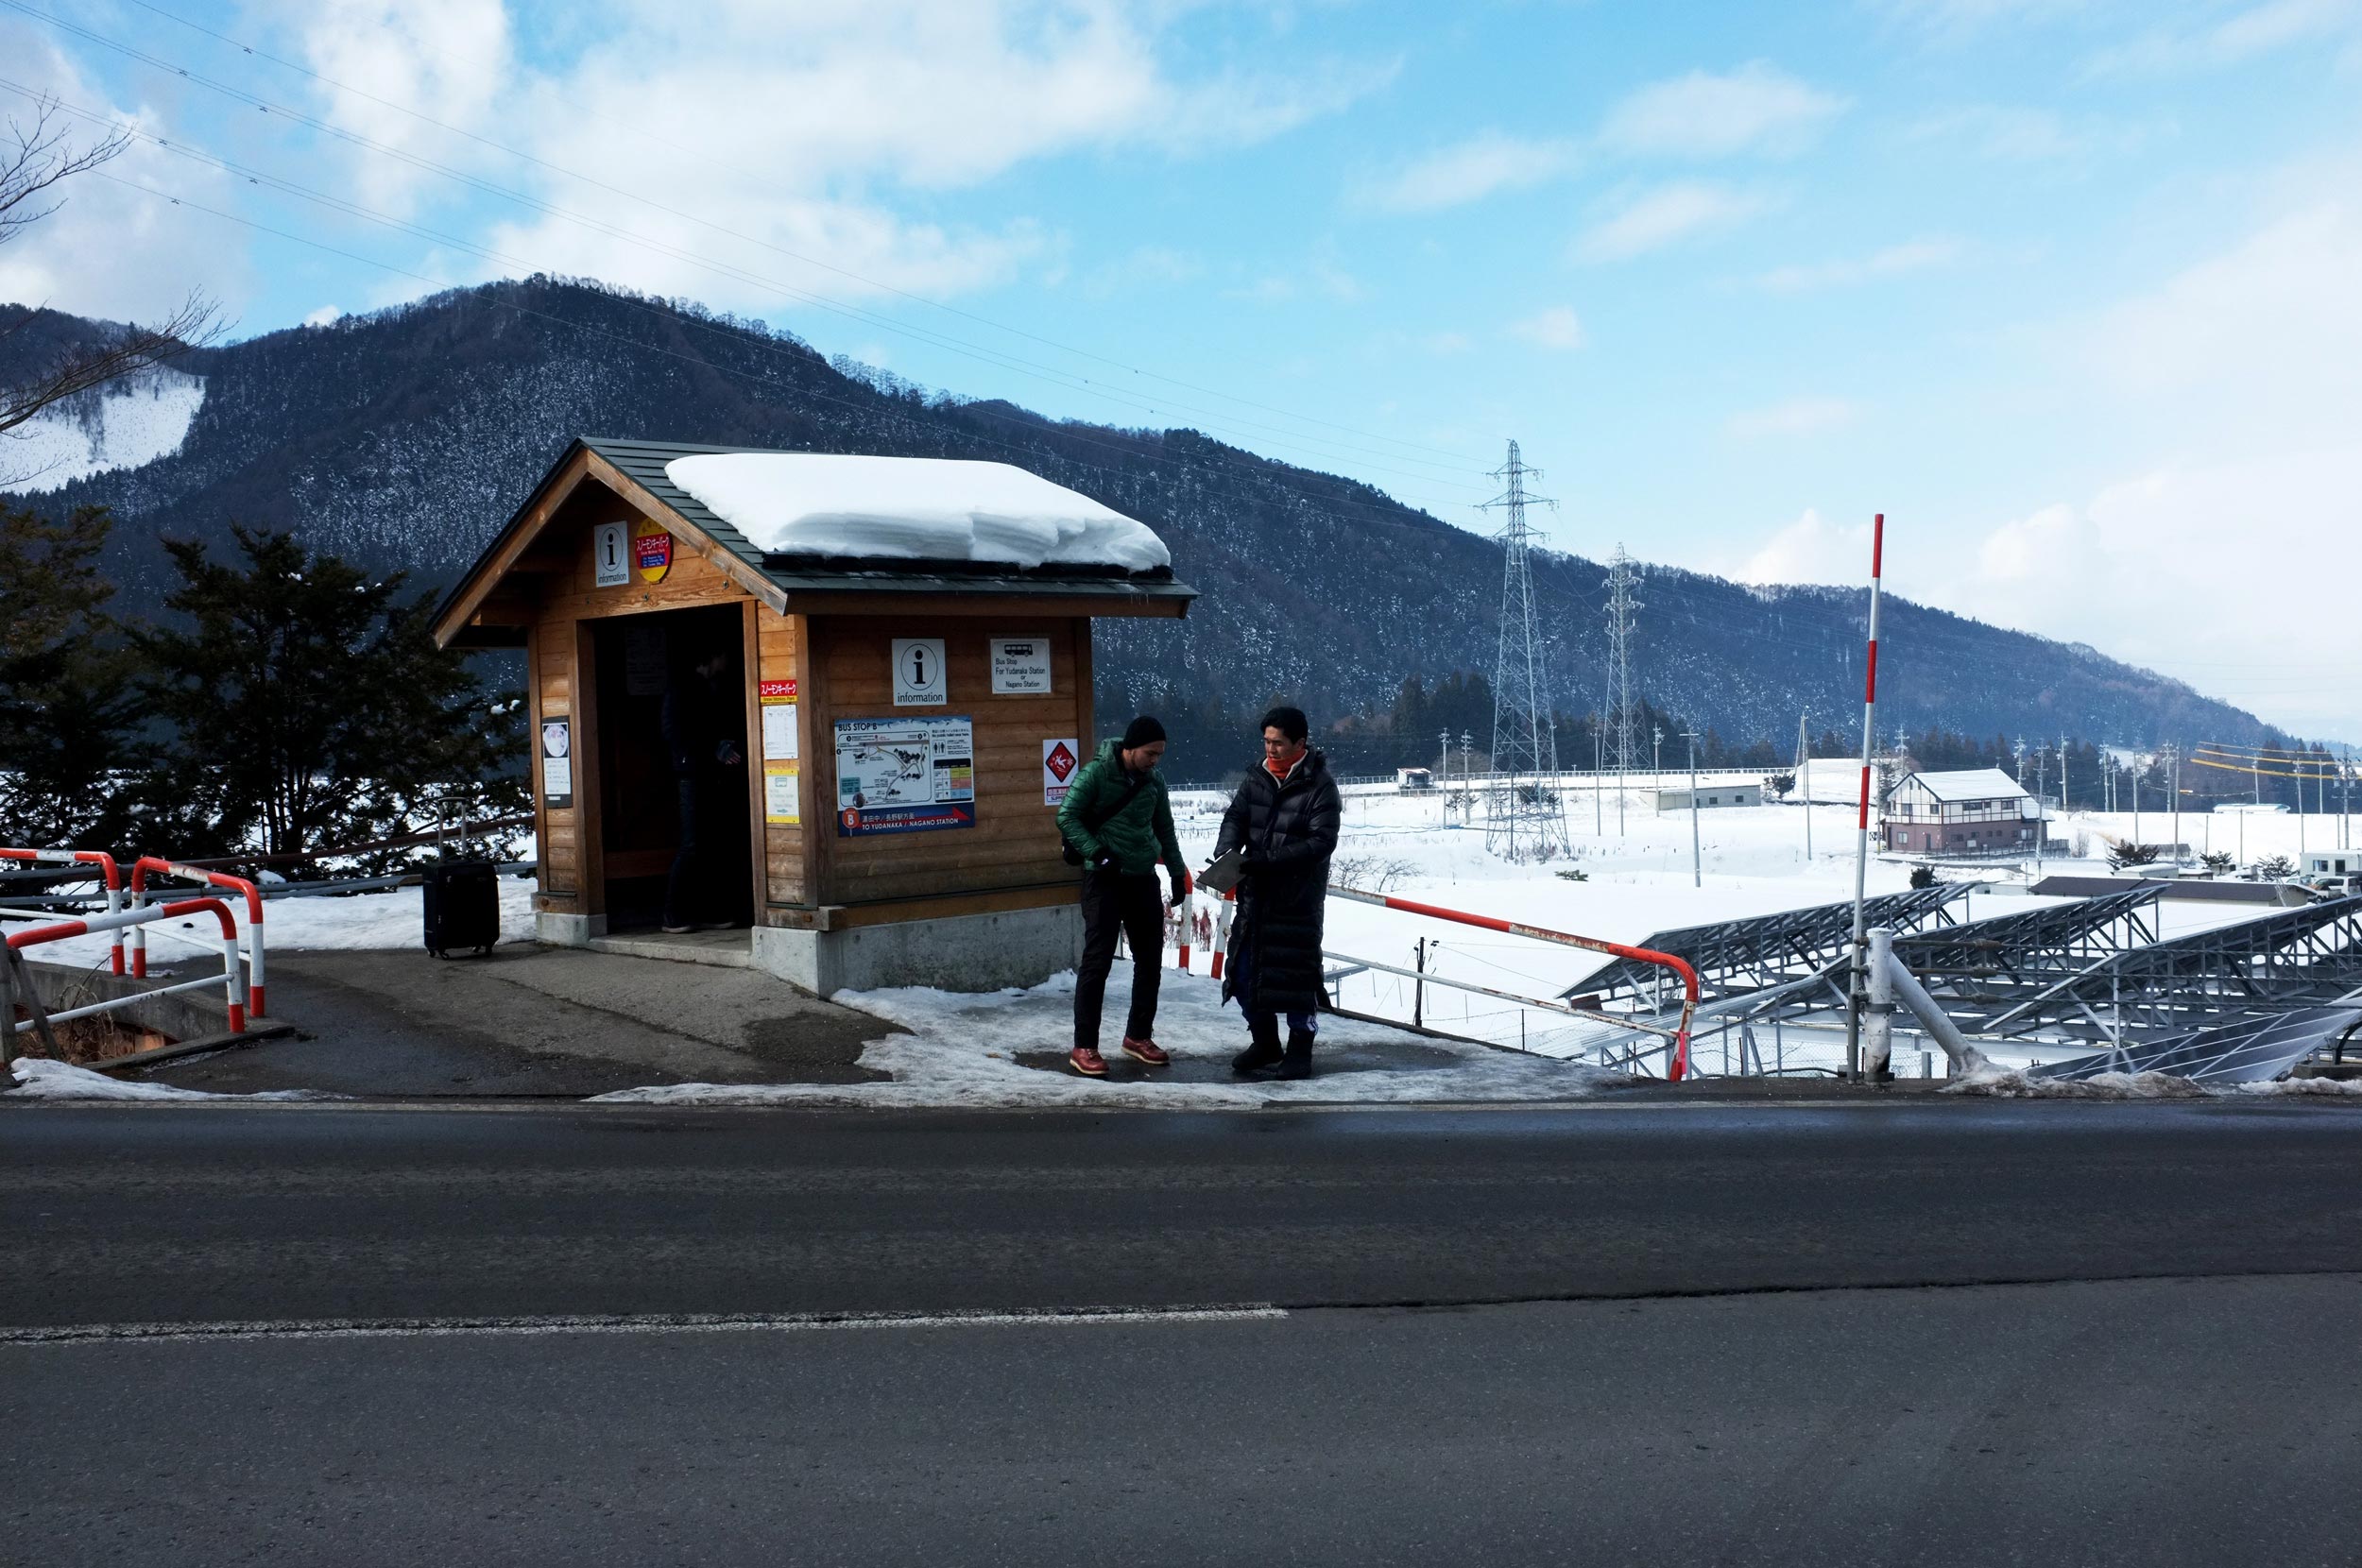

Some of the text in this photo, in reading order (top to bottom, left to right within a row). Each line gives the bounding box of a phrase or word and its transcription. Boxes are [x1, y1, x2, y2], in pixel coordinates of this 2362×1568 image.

[636, 537, 669, 551] スノーモンキーパーク
[598, 572, 627, 583] information
[995, 666, 1045, 675] For Yudanaka Station
[761, 682, 796, 695] スノーモンキーパーク
[1006, 681, 1023, 689] Nagano
[897, 691, 943, 703] information
[838, 724, 851, 732] BUS
[853, 723, 871, 731] STOP
[847, 814, 854, 826] B
[871, 822, 903, 830] YUDANAKA
[909, 819, 935, 827] NAGANO
